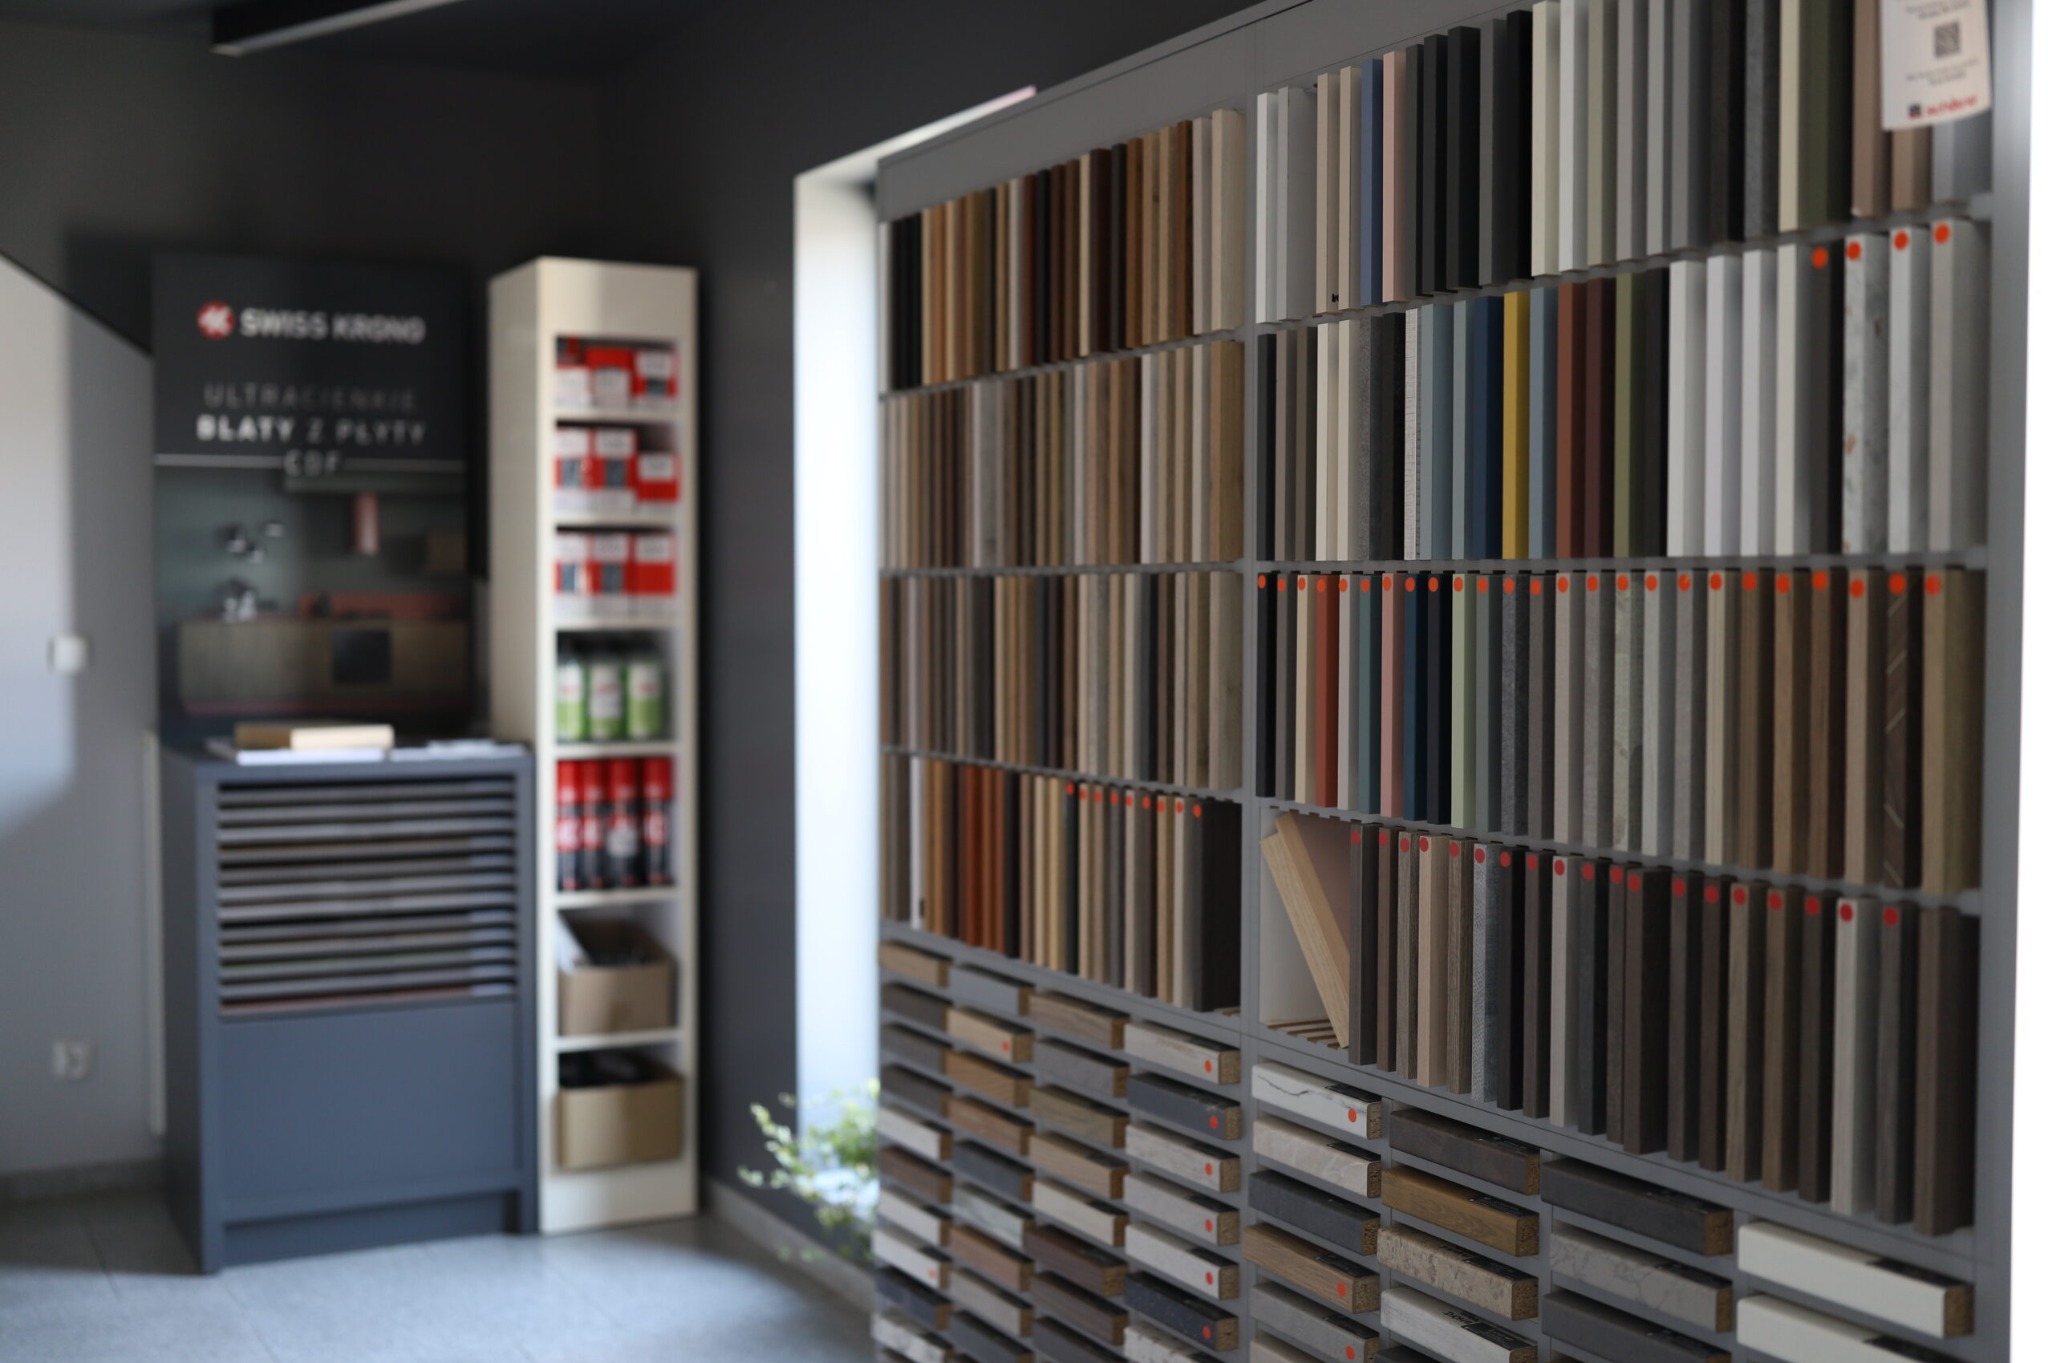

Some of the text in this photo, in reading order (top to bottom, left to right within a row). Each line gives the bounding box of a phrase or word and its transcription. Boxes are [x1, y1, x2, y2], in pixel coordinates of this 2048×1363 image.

[240, 308, 427, 345] SWISS KRONO
[196, 414, 296, 443] BLATY
